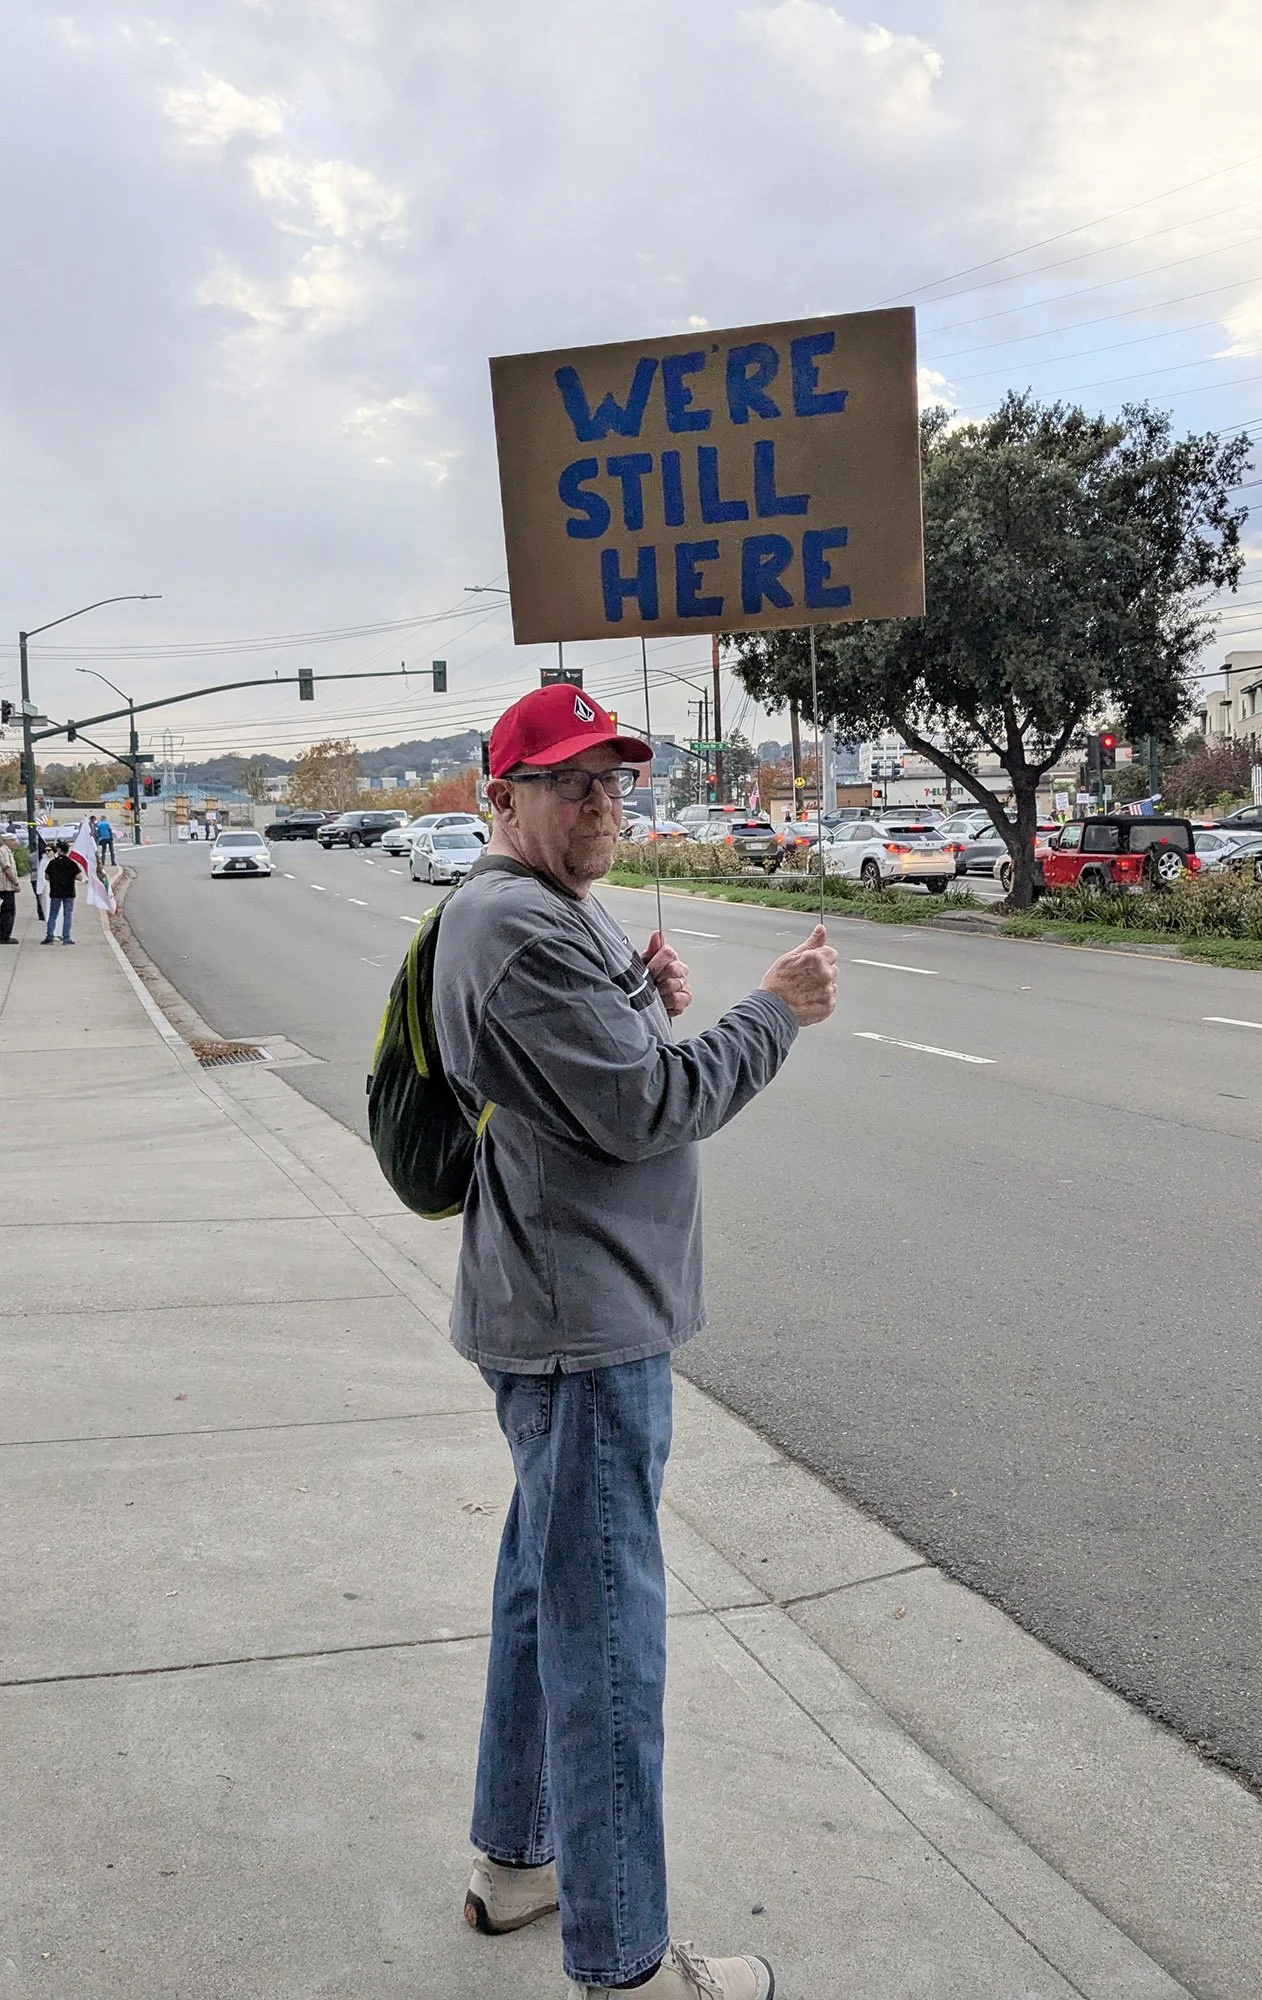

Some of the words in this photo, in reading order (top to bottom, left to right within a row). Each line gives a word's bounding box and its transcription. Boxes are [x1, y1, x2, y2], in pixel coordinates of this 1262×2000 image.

[555, 331, 849, 442] WE'RE
[558, 439, 811, 539] STILL
[601, 526, 852, 622] HERE
